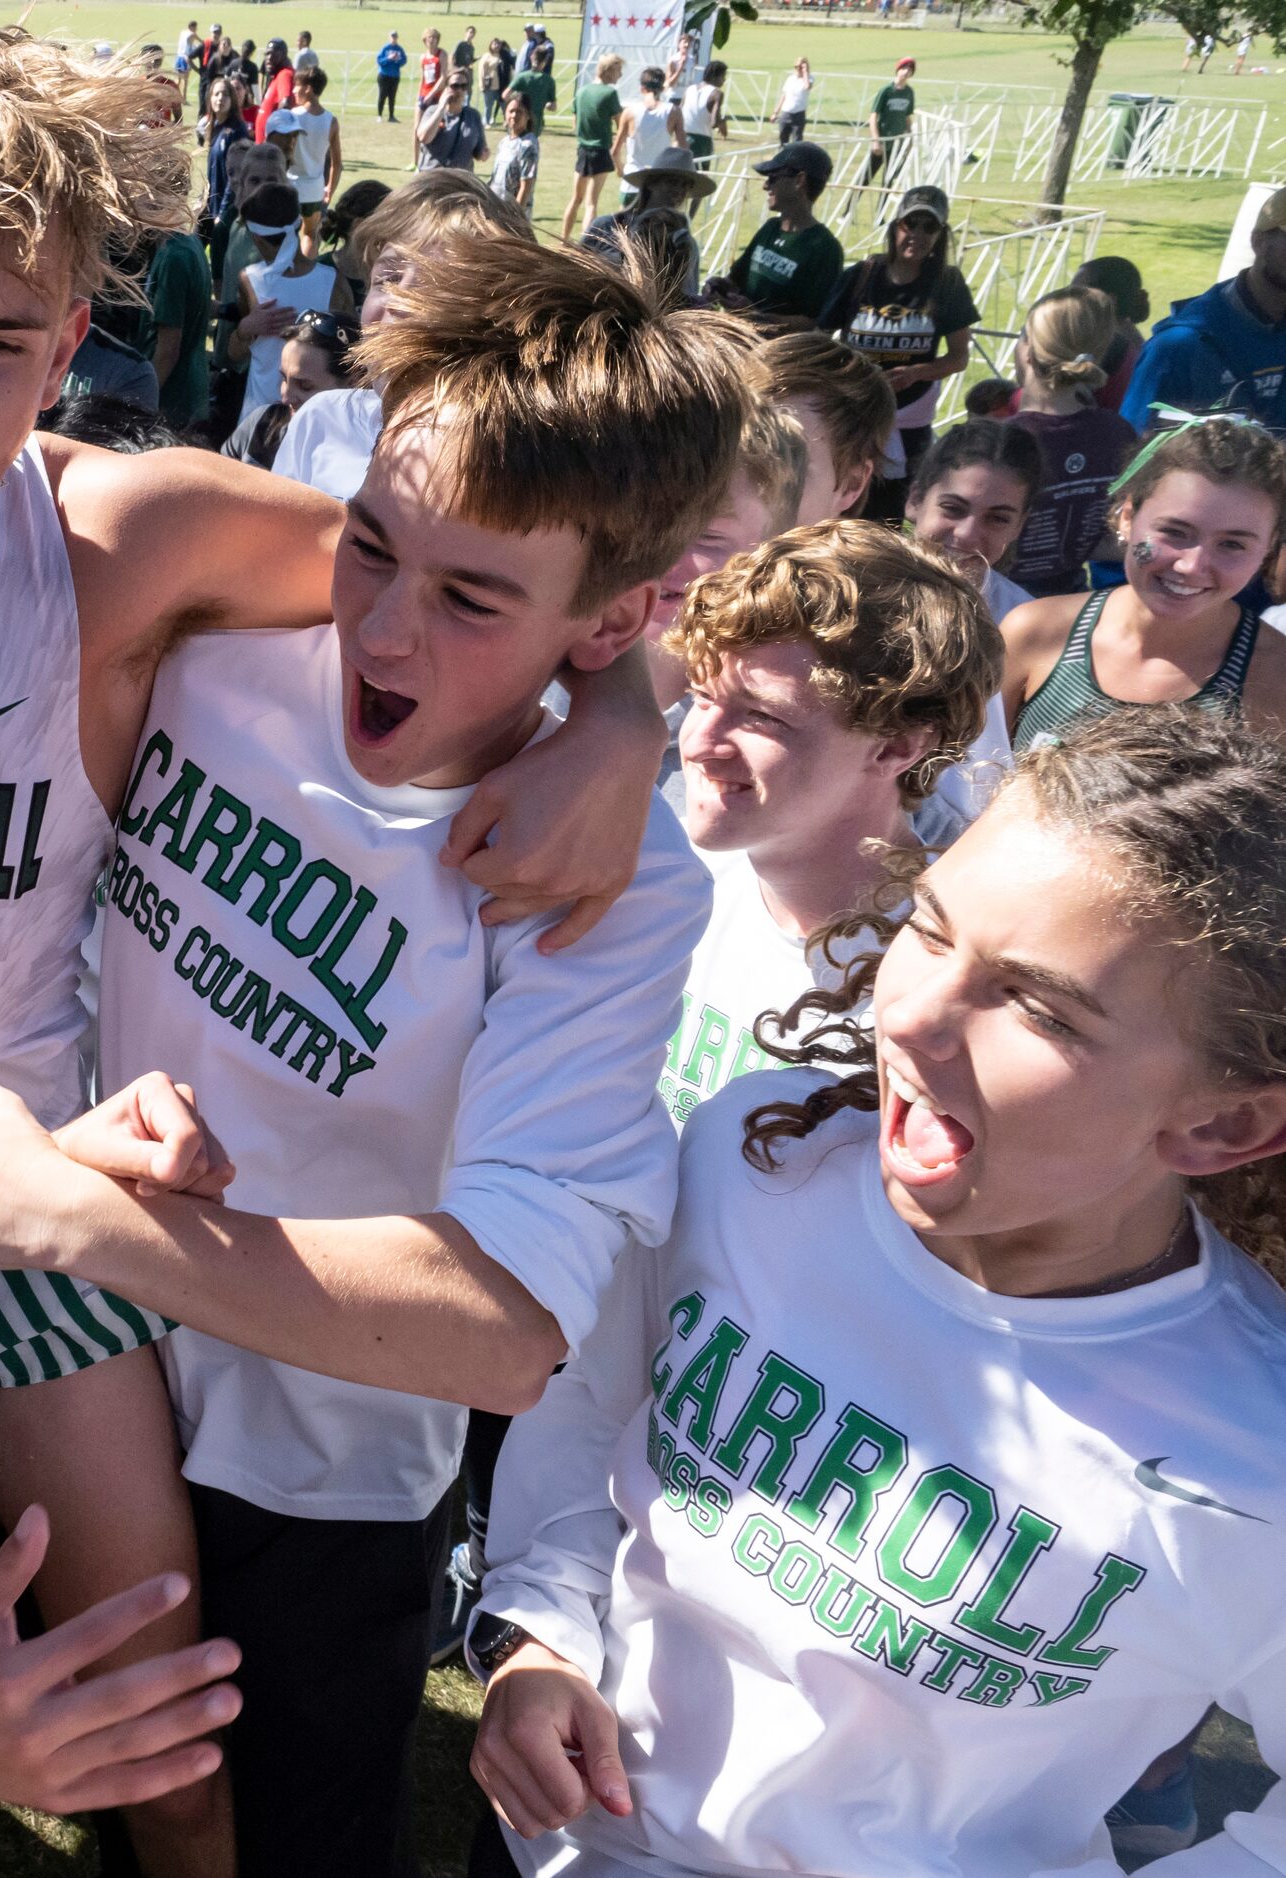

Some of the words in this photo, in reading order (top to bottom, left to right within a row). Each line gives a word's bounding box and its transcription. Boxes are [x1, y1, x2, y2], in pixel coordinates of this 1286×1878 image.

[847, 332, 894, 349] KLEIN
[898, 336, 933, 349] OAK
[110, 845, 180, 953] ROSS
[174, 925, 377, 1098] COUNTRY
[117, 728, 409, 1053] CARROLL
[650, 1290, 1148, 1670] CARROLL
